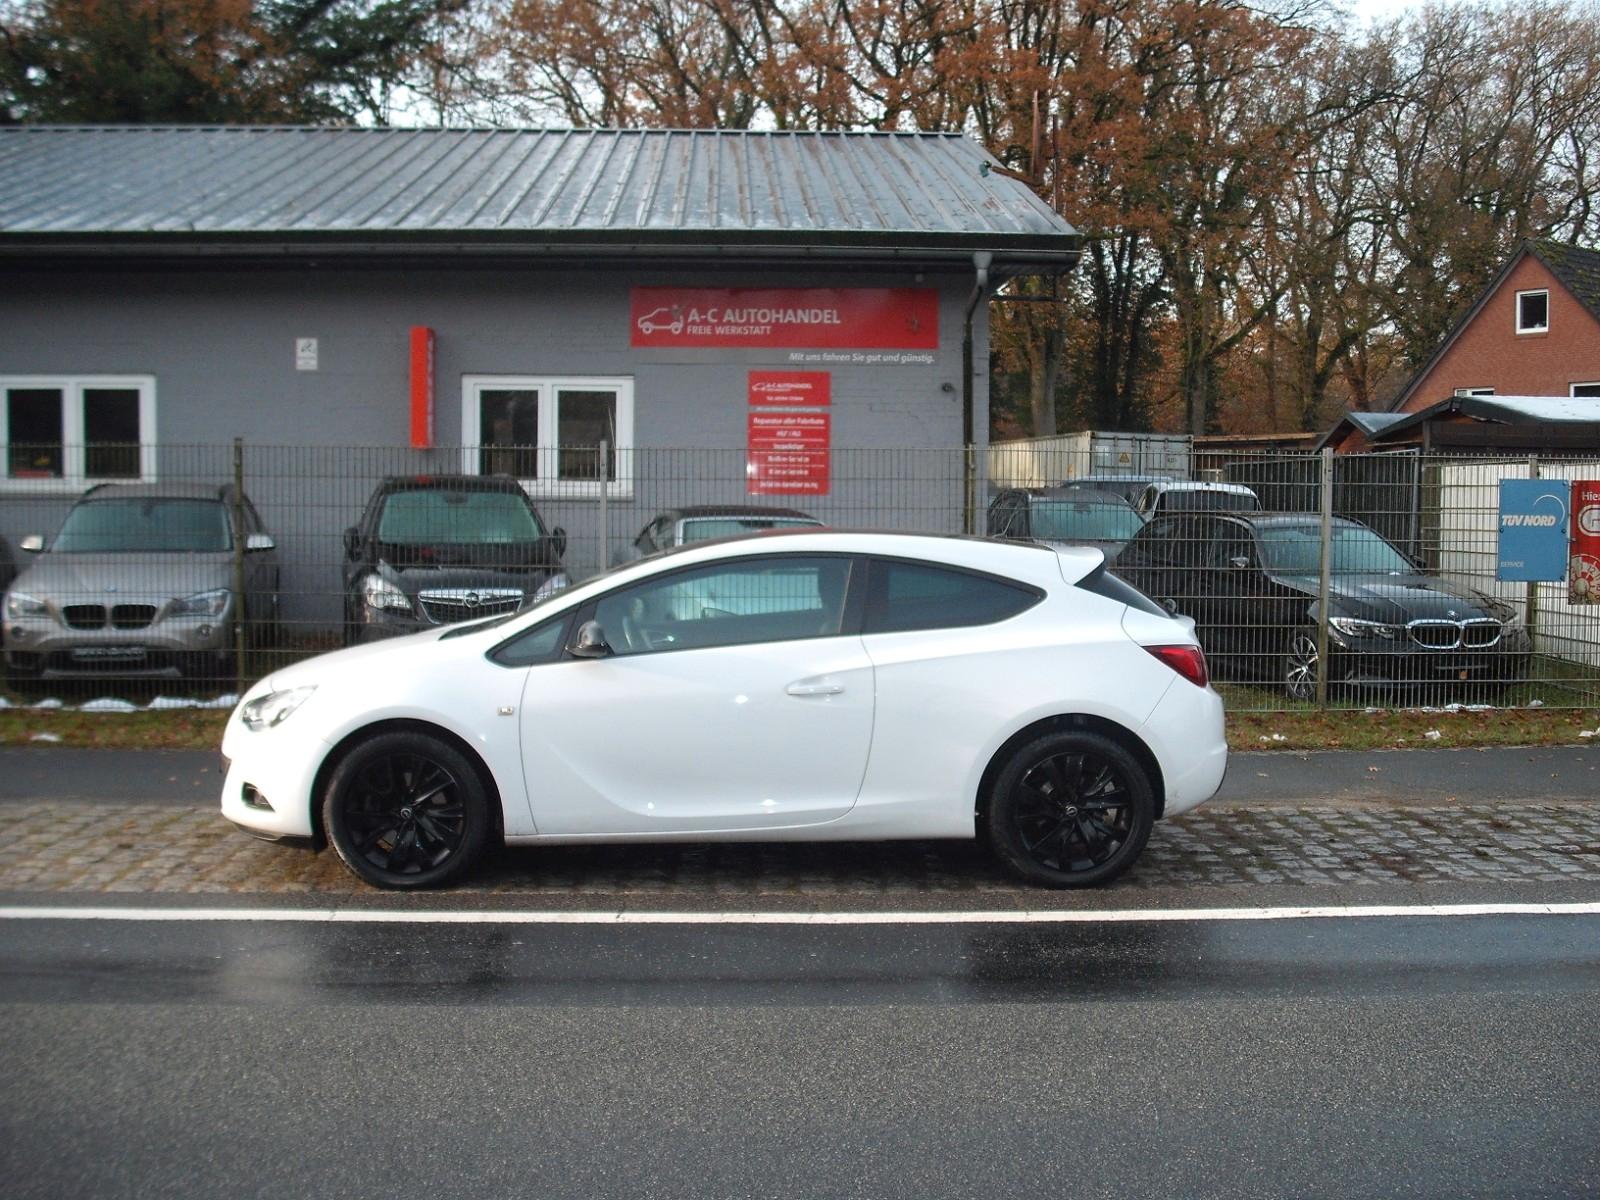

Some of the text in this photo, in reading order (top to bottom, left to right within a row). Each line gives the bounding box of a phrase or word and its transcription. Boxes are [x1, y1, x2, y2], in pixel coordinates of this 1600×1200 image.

[687, 308, 840, 324] A-C AUTOHANDEL
[687, 325, 772, 336] FREIE WERKSTATT
[789, 352, 804, 361] Mit
[822, 353, 850, 361] fahren
[852, 353, 865, 362] Sie
[866, 354, 881, 364] gut
[882, 353, 900, 362] und
[1523, 515, 1556, 526] NORD
